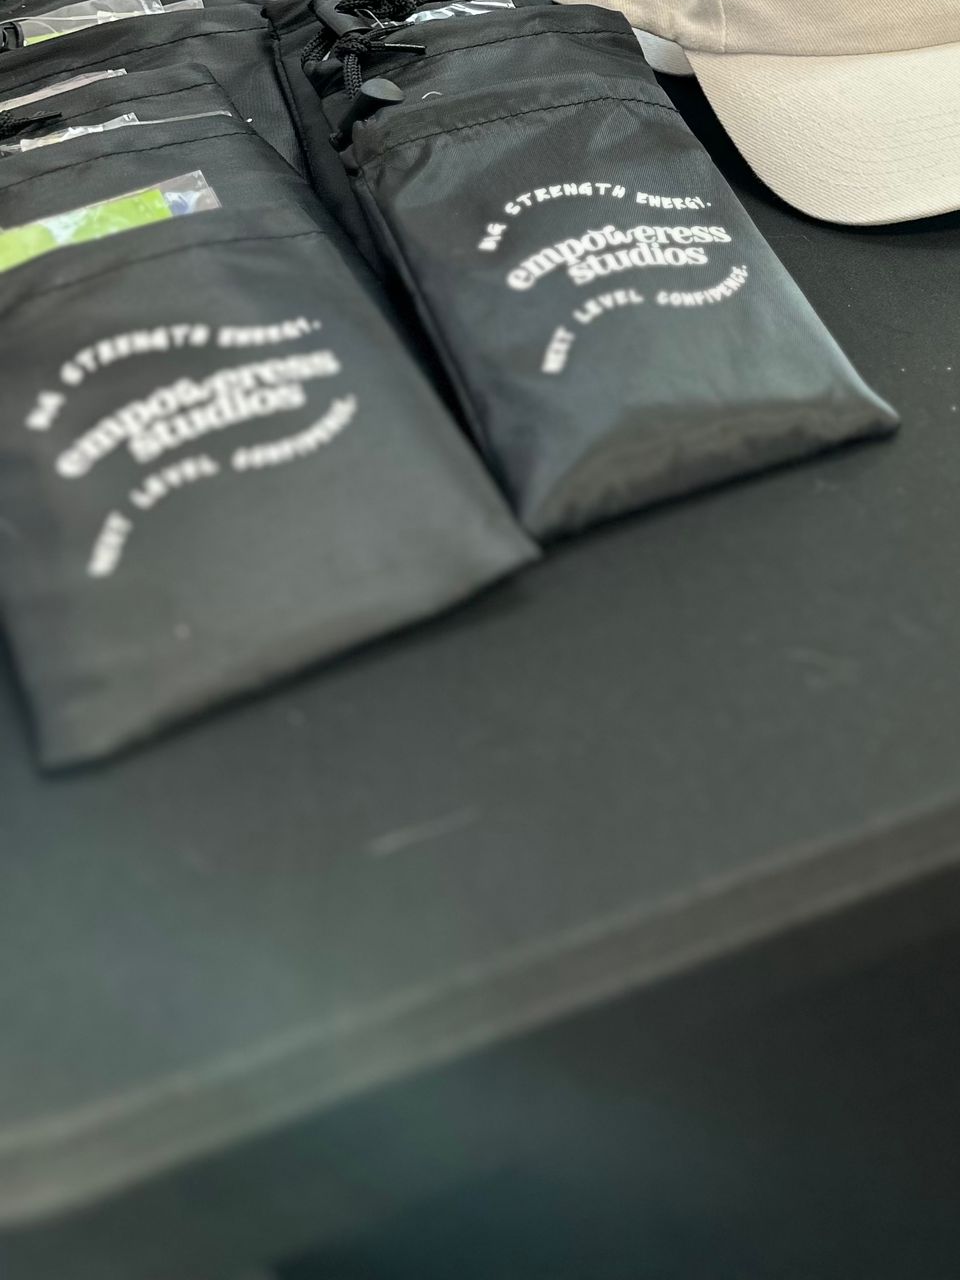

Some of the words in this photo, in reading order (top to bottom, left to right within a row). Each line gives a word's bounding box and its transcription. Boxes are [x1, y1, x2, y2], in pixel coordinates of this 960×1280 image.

[504, 182, 626, 216] STRENGTH
[507, 224, 732, 291] empoweress
[568, 242, 709, 286] studios
[572, 289, 645, 325] LEVEL
